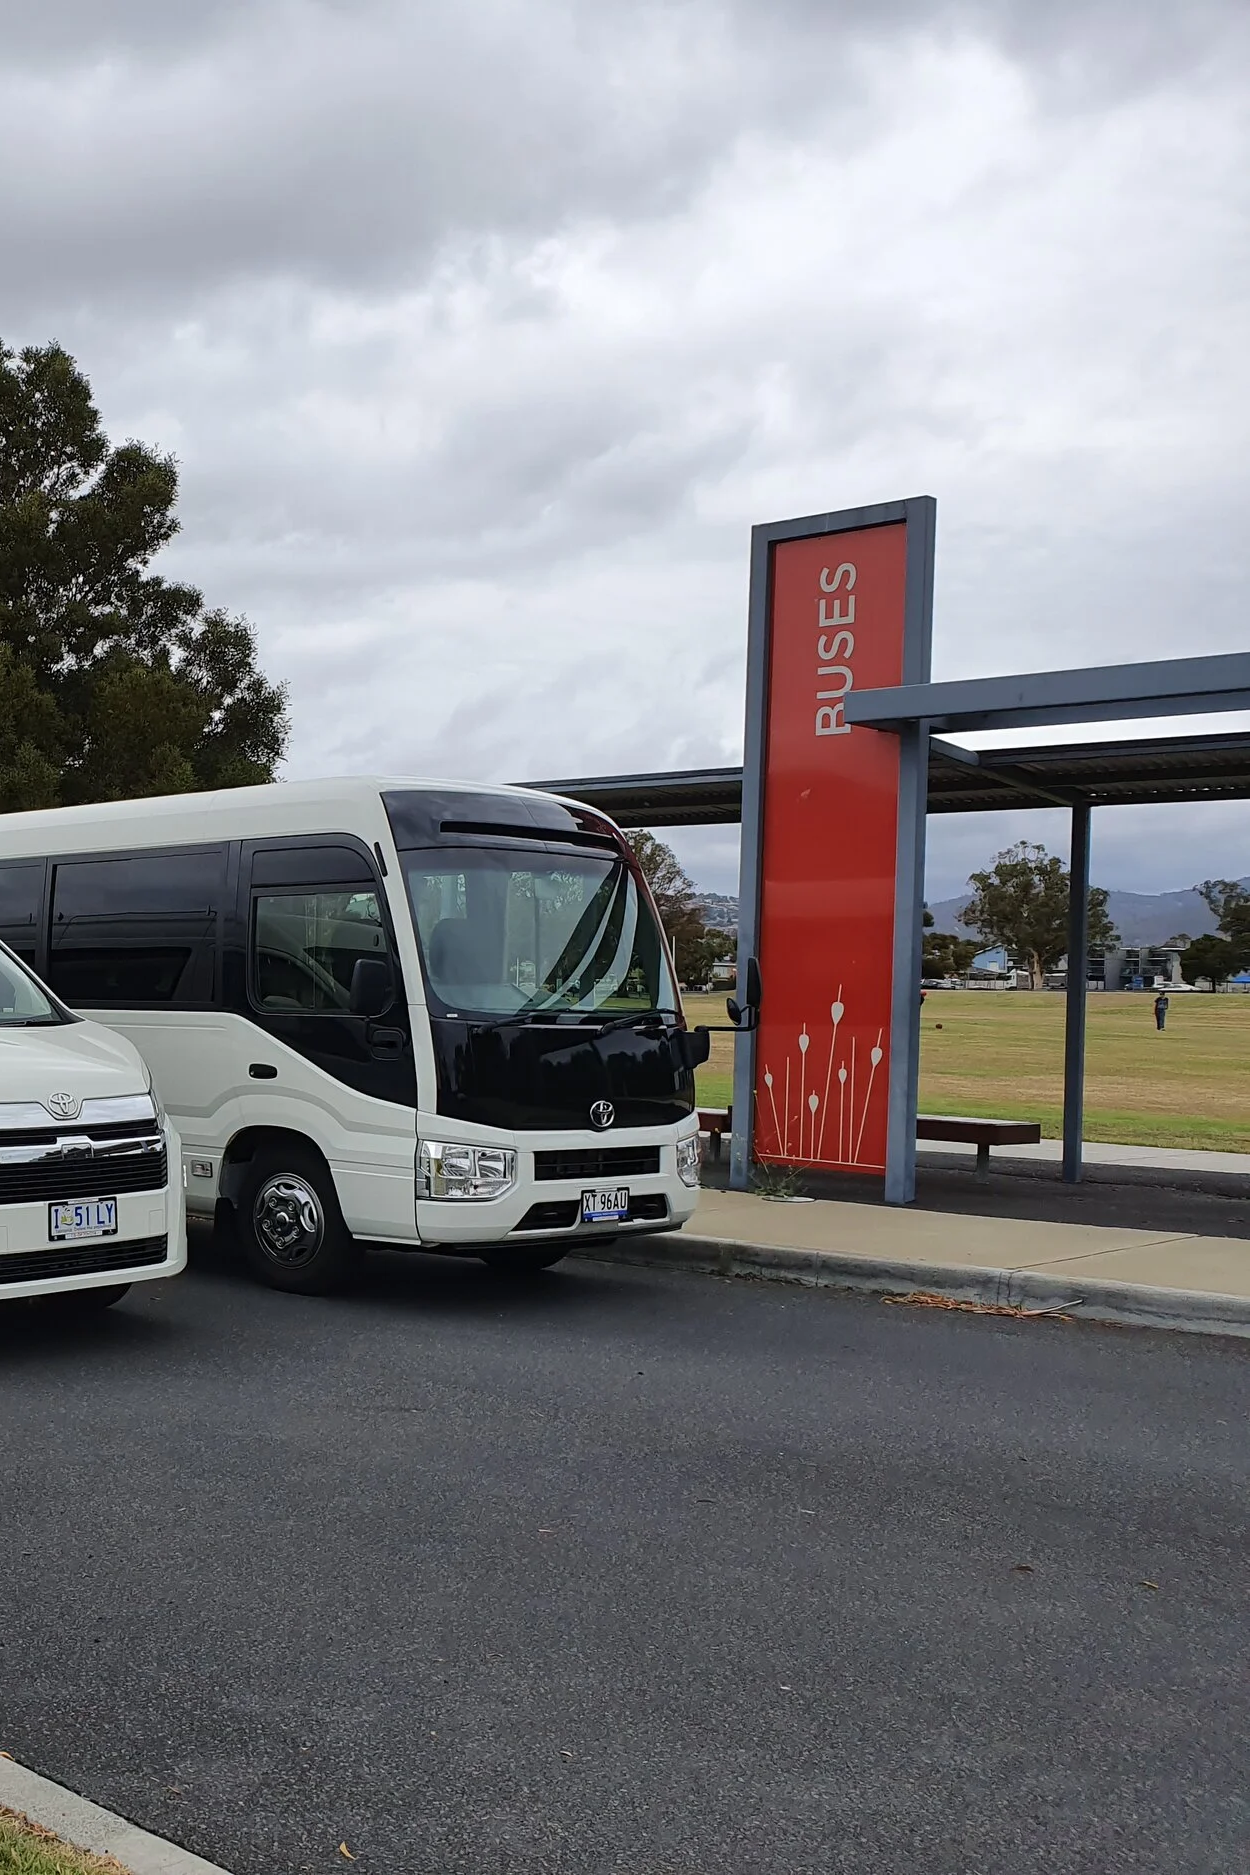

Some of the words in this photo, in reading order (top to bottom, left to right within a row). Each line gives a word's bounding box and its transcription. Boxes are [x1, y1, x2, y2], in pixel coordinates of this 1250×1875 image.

[815, 562, 857, 735] BUSES
[584, 1193, 597, 1212] XT
[600, 1192, 627, 1211] 96AU
[75, 1206, 90, 1226] 51
[97, 1204, 113, 1224] LY
